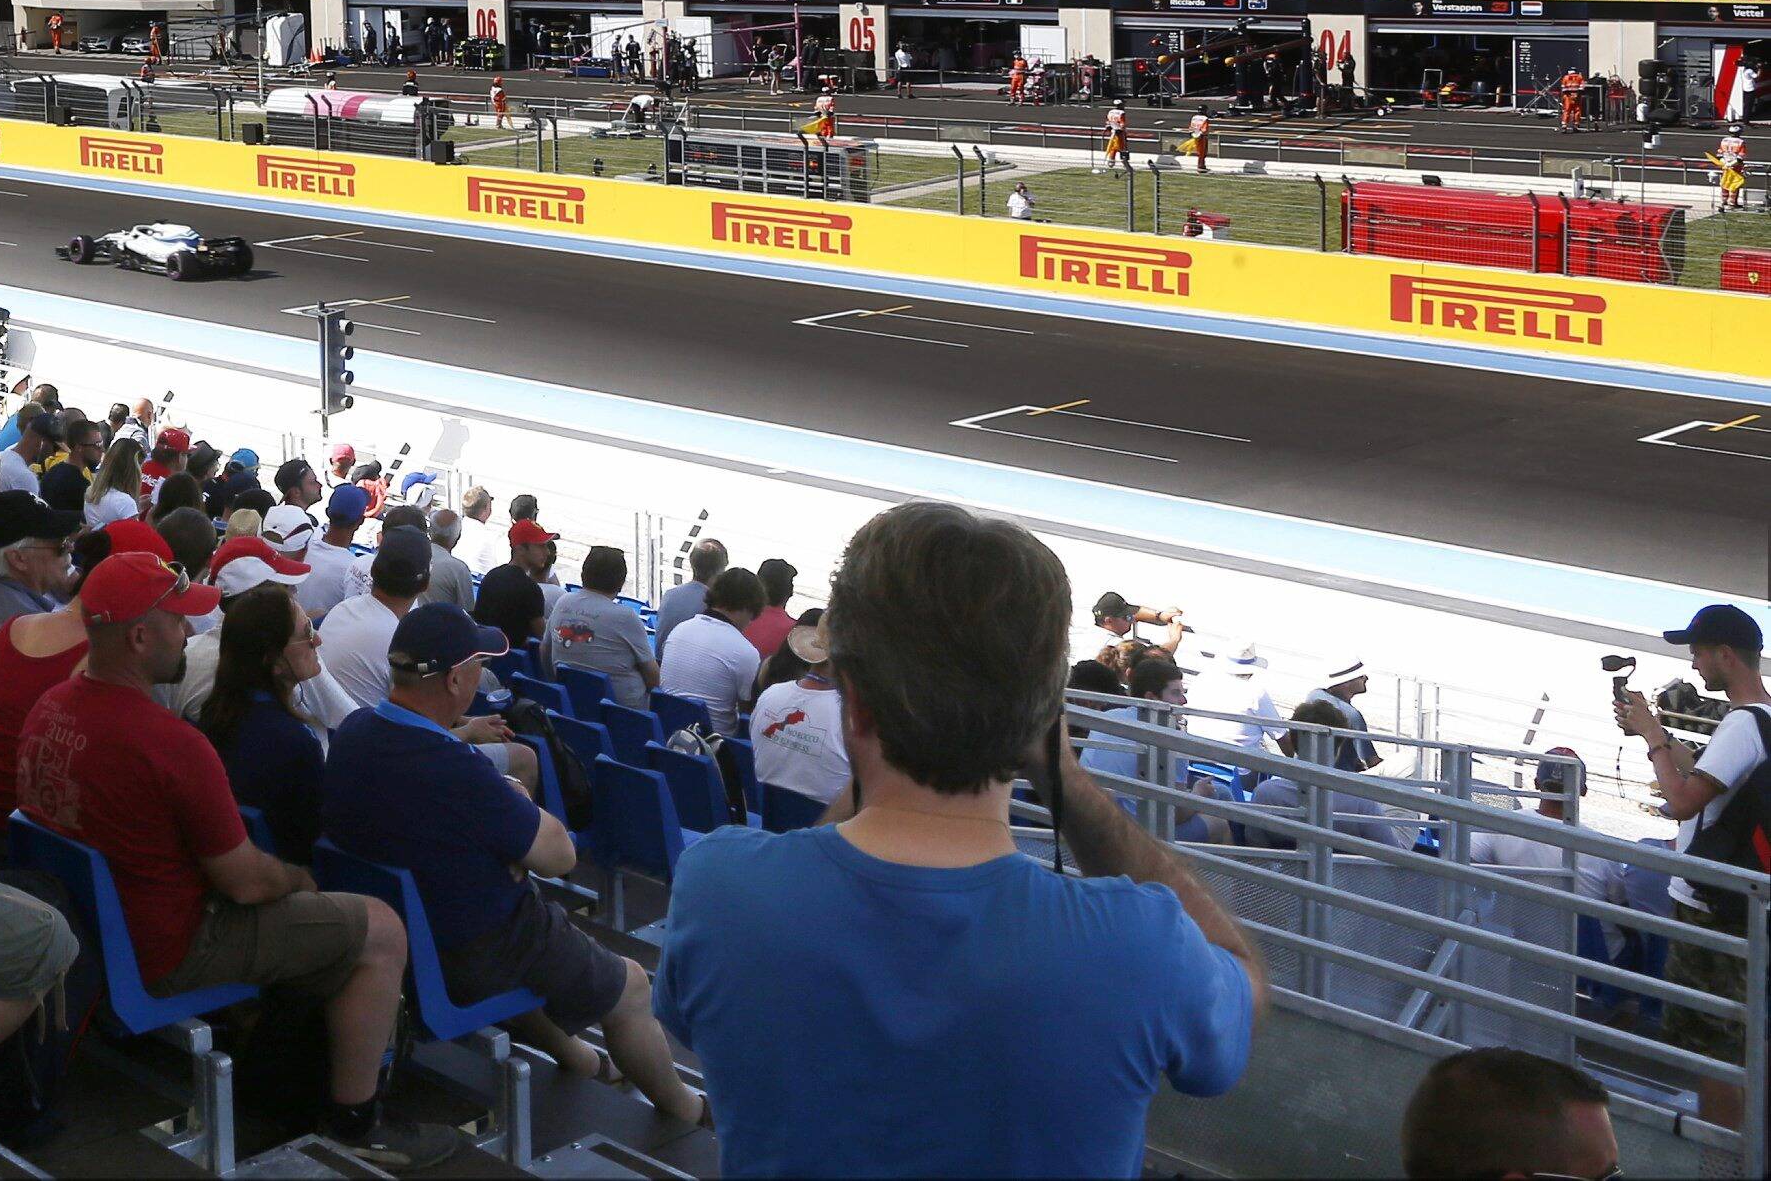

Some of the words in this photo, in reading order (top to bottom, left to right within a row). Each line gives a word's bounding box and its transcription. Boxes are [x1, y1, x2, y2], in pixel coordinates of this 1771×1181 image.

[476, 9, 497, 39] 06
[1432, 4, 1483, 12] Verstappen
[849, 17, 876, 52] 05
[80, 136, 163, 176] PIRELLI
[257, 154, 356, 198] PIRELLI
[467, 176, 585, 225] PIRELLI
[711, 201, 853, 256] PIRELLI
[1019, 234, 1193, 297] PIRELLI
[1390, 274, 1607, 346] PIRELLI
[45, 720, 87, 751] auto
